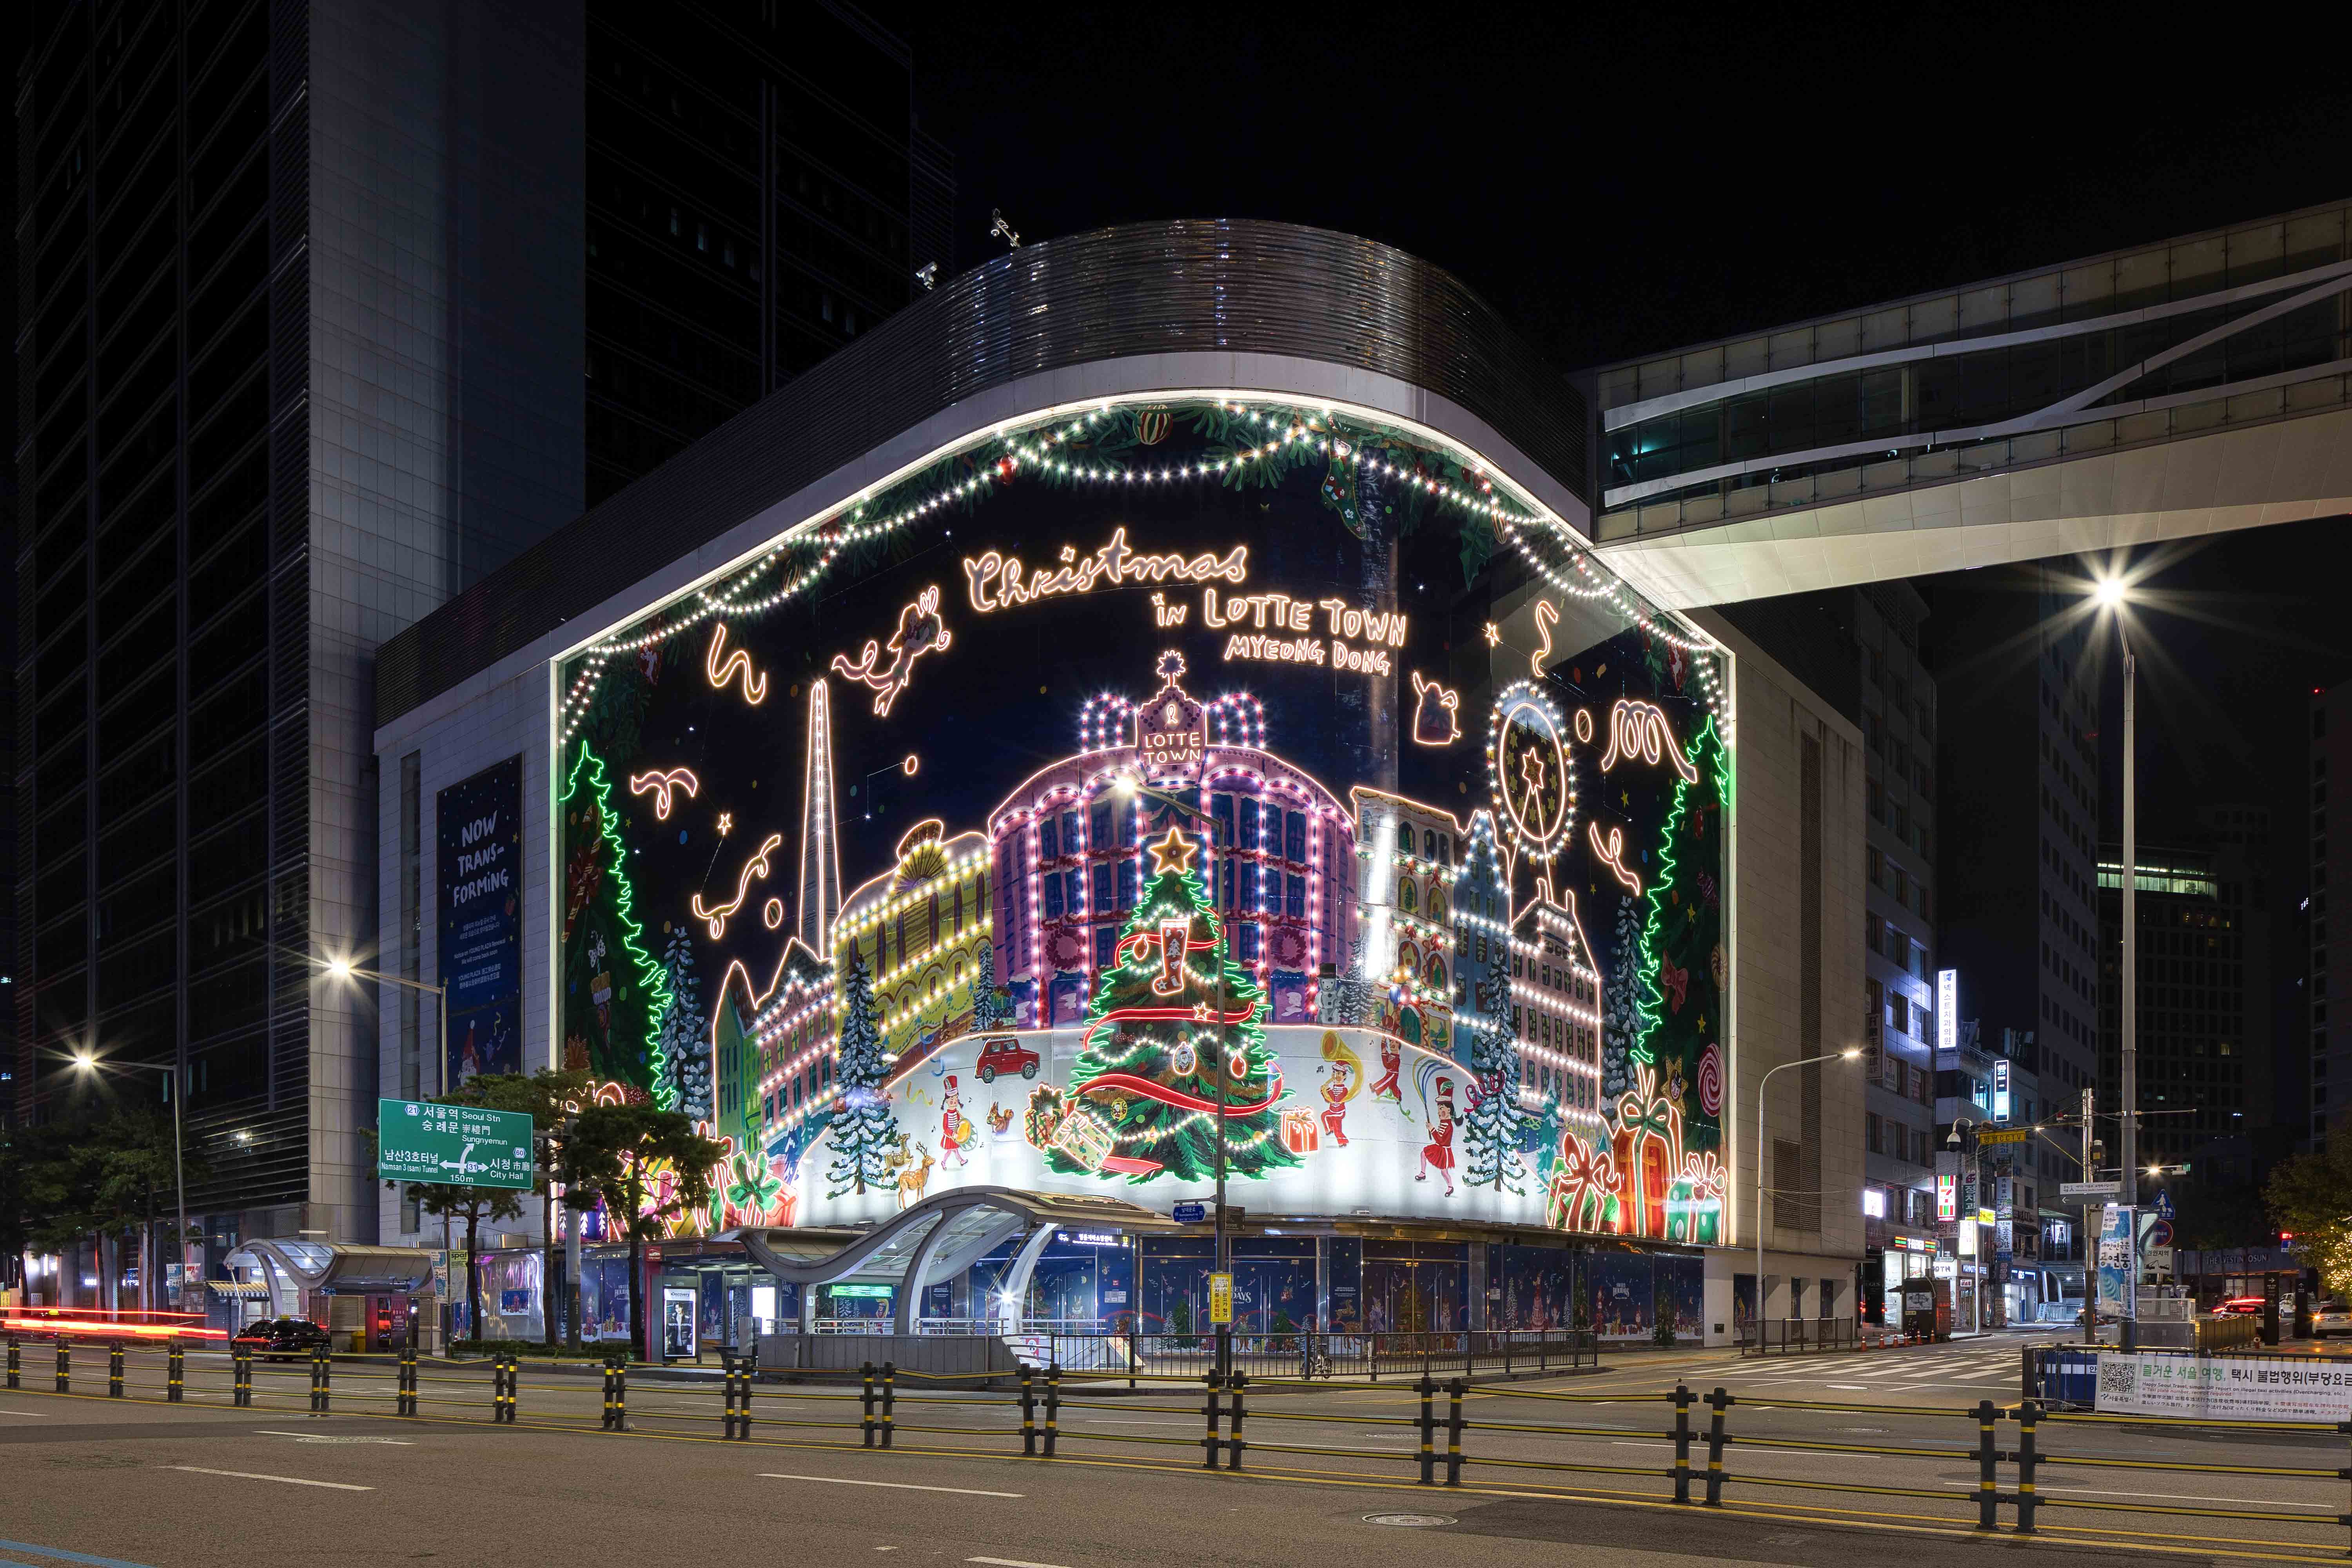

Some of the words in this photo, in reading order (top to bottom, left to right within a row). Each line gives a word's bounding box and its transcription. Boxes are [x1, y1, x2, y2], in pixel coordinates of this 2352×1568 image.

[964, 526, 1247, 612] Christmas
[1152, 592, 1188, 626] in
[1204, 588, 1312, 630] LOTTE
[1322, 598, 1406, 647] TOWN
[1225, 634, 1325, 663] MYEONG
[1332, 639, 1390, 676] DONG
[1143, 731, 1201, 748] LOTTE
[1143, 748, 1201, 764] TOWN
[461, 810, 497, 847] NOW
[457, 846, 505, 877] TRANS-
[453, 868, 509, 908] FORMING
[423, 1106, 458, 1120] 서울역
[462, 1111, 484, 1121] Seoul
[486, 1114, 500, 1122] Stn
[422, 1120, 458, 1134] 숭례문
[462, 1134, 507, 1145] Sungnyemun
[385, 1149, 438, 1165] 남산3호터널
[490, 1158, 510, 1170] 시청
[381, 1163, 401, 1171] Namsan
[423, 1165, 438, 1174] Tunnel
[490, 1171, 506, 1180] City
[450, 1174, 474, 1183] 150m
[1965, 1185, 1976, 1210] 정치과
[1939, 1224, 1948, 1233] 약
[2205, 1256, 2218, 1264] THE
[2248, 1254, 2267, 1262] OSUN
[2143, 1365, 2172, 1378] 즐거운
[2177, 1365, 2197, 1379] 서울
[2202, 1367, 2226, 1382] 여행,
[2231, 1369, 2252, 1382] 택시
